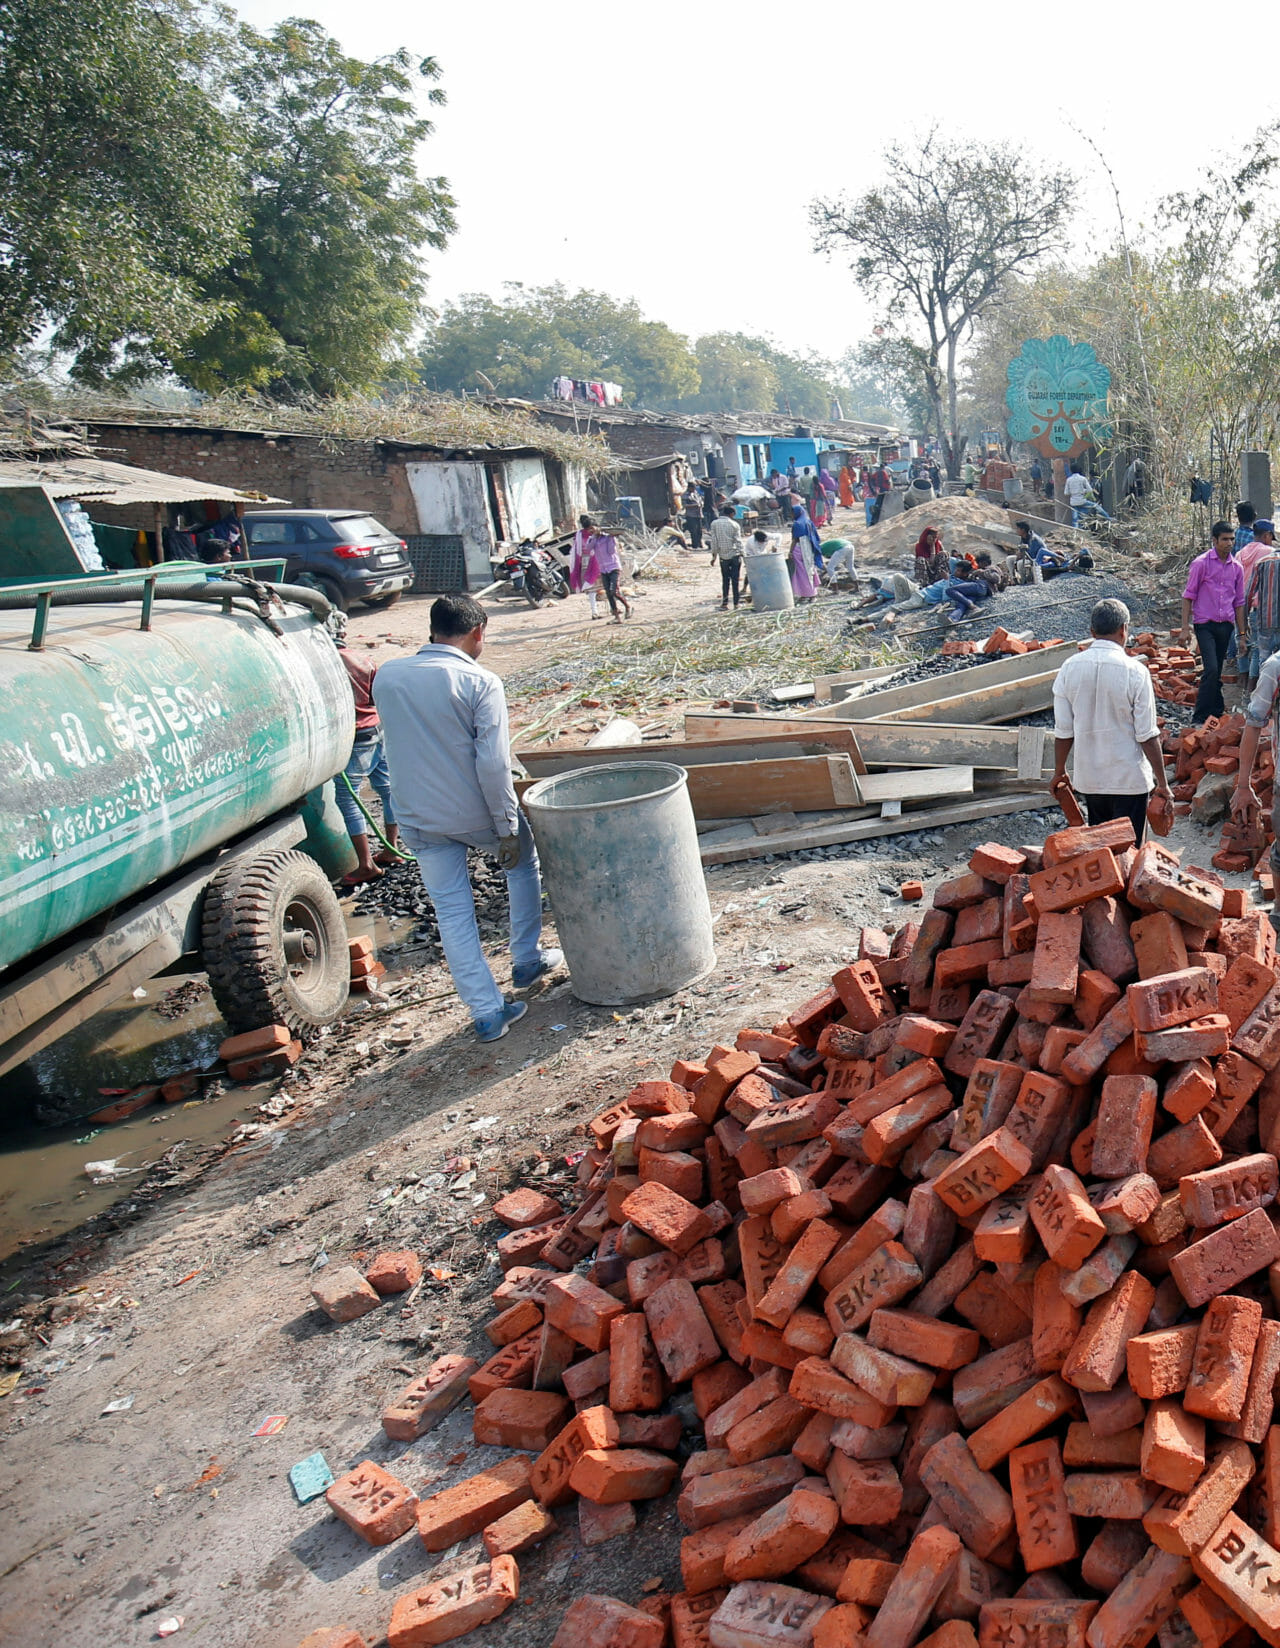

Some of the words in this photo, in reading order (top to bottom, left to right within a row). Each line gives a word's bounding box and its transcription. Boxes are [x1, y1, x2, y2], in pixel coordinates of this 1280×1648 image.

[1062, 858, 1101, 891] BK
[1157, 985, 1193, 1016] BK
[965, 1001, 997, 1043] BK
[1013, 1087, 1046, 1133] BK
[945, 1169, 991, 1204] BK
[834, 1275, 873, 1323] BK
[487, 1346, 531, 1376] BK
[551, 1428, 585, 1478] BK
[351, 1480, 396, 1514] BK
[1023, 1458, 1057, 1518] BK
[1213, 1529, 1273, 1588] BK
[752, 1595, 824, 1629] BK
